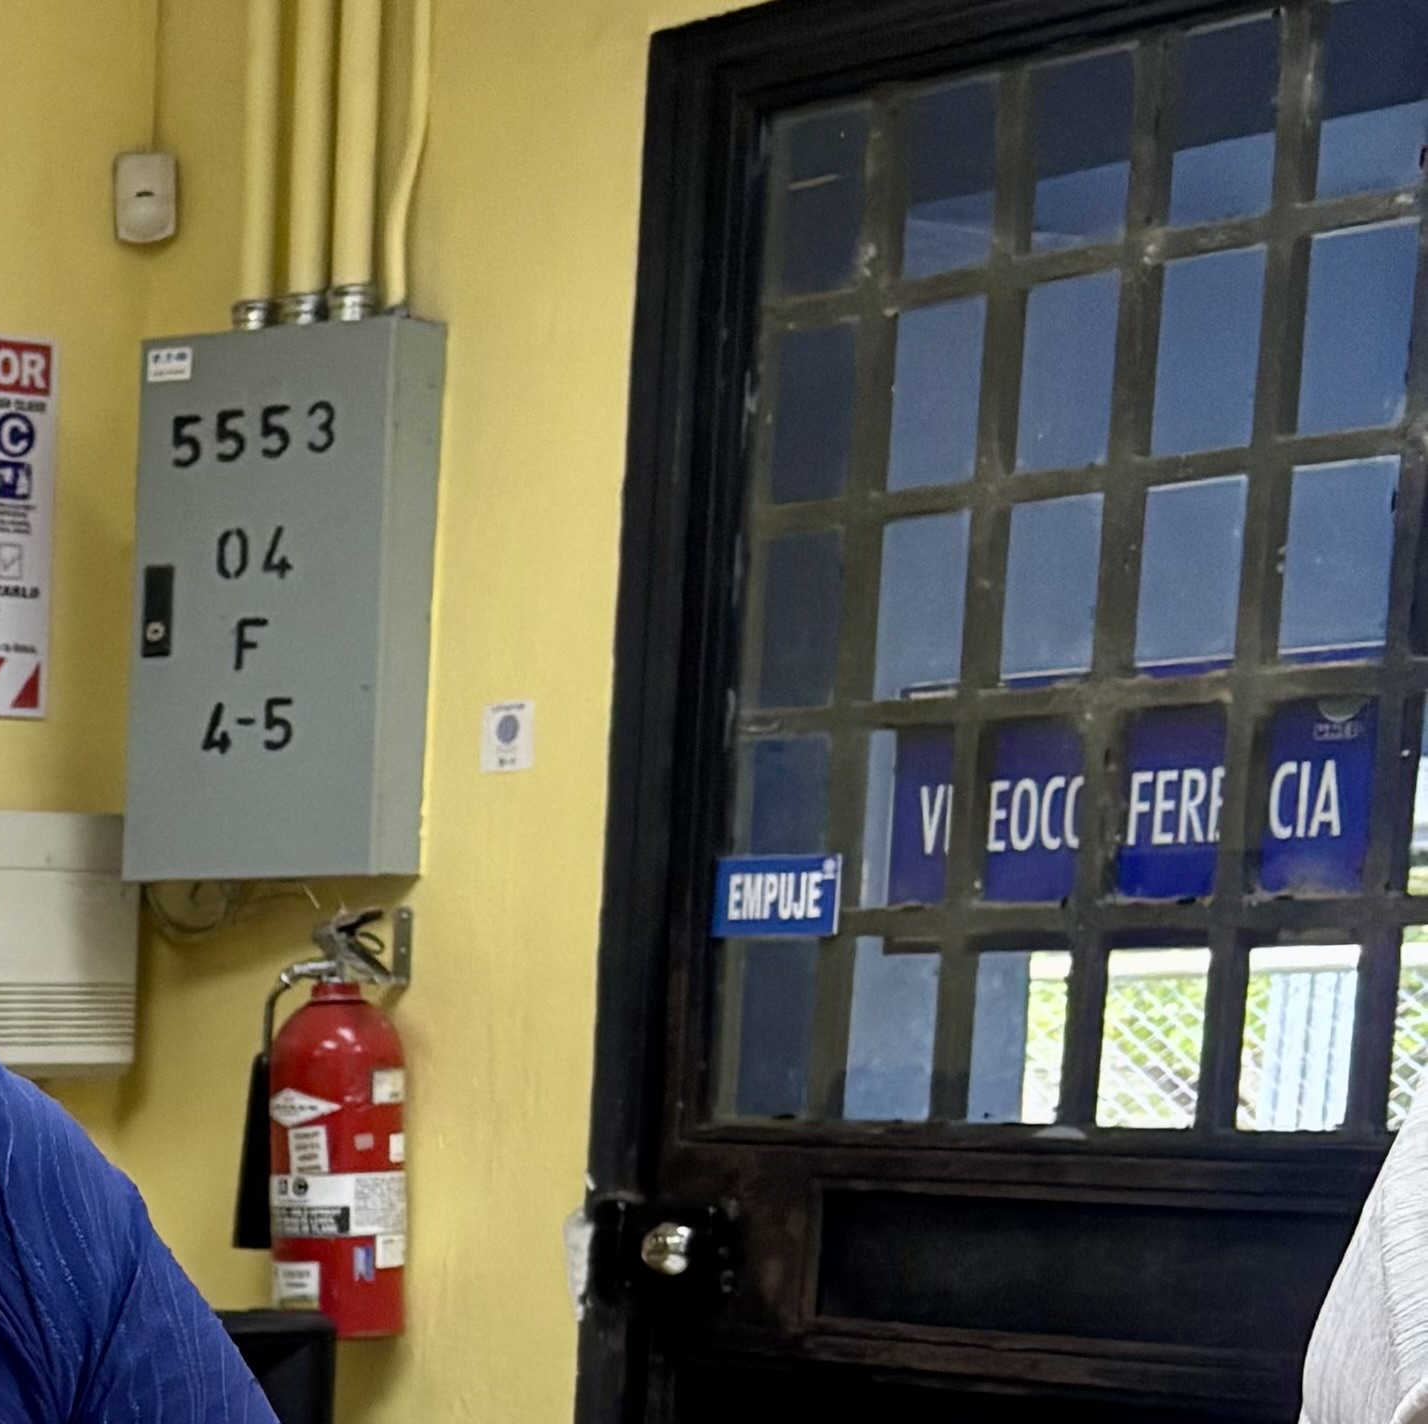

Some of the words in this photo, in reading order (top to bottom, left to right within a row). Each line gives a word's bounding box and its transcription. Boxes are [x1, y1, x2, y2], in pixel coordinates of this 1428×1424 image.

[0, 418, 30, 454] C
[171, 400, 336, 469] 5553
[216, 525, 293, 580] 04
[233, 617, 269, 671] F
[201, 697, 293, 755] 4-5
[727, 870, 824, 920] EMPUJE
